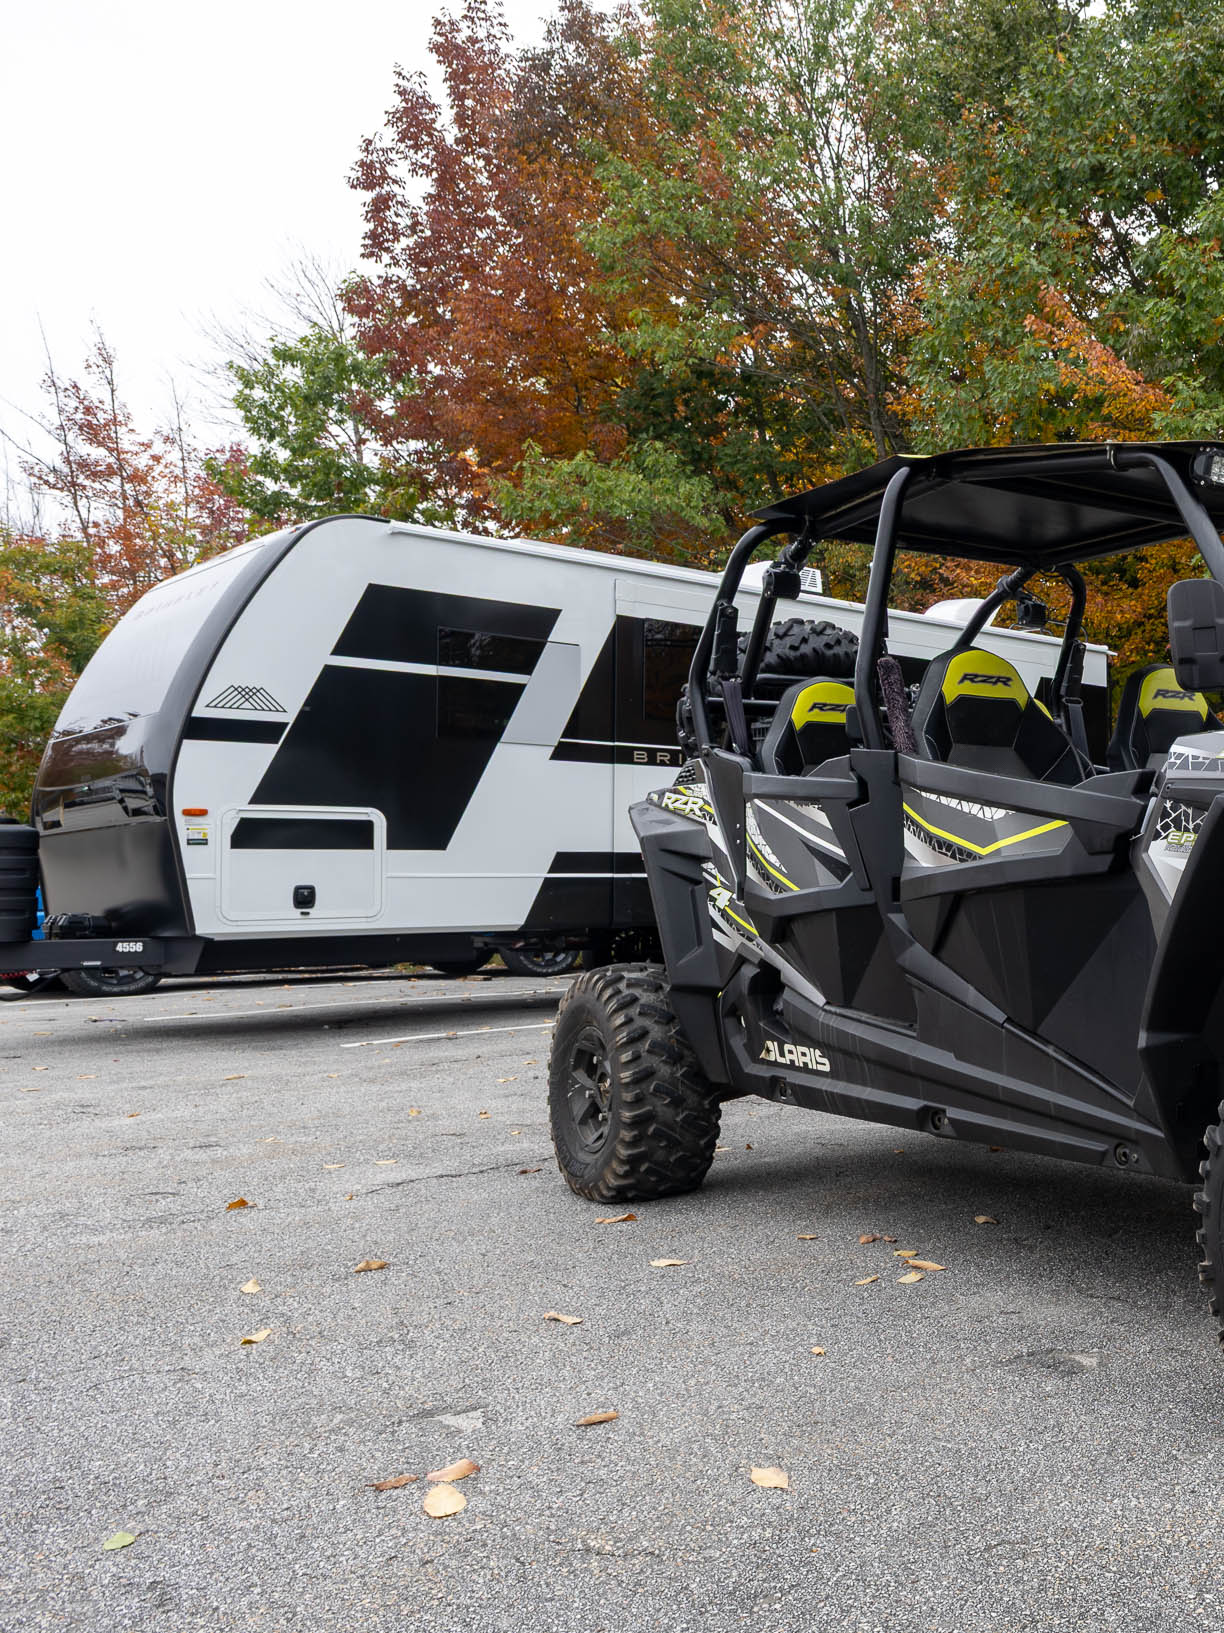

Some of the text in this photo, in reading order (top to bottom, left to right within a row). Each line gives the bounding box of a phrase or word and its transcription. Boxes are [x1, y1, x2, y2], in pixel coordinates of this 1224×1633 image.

[957, 673, 1013, 687] RZR
[1152, 688, 1195, 701] RZR
[661, 791, 705, 818] RZR
[1166, 831, 1197, 845] EP
[708, 886, 734, 910] 4
[116, 942, 143, 952] 4556
